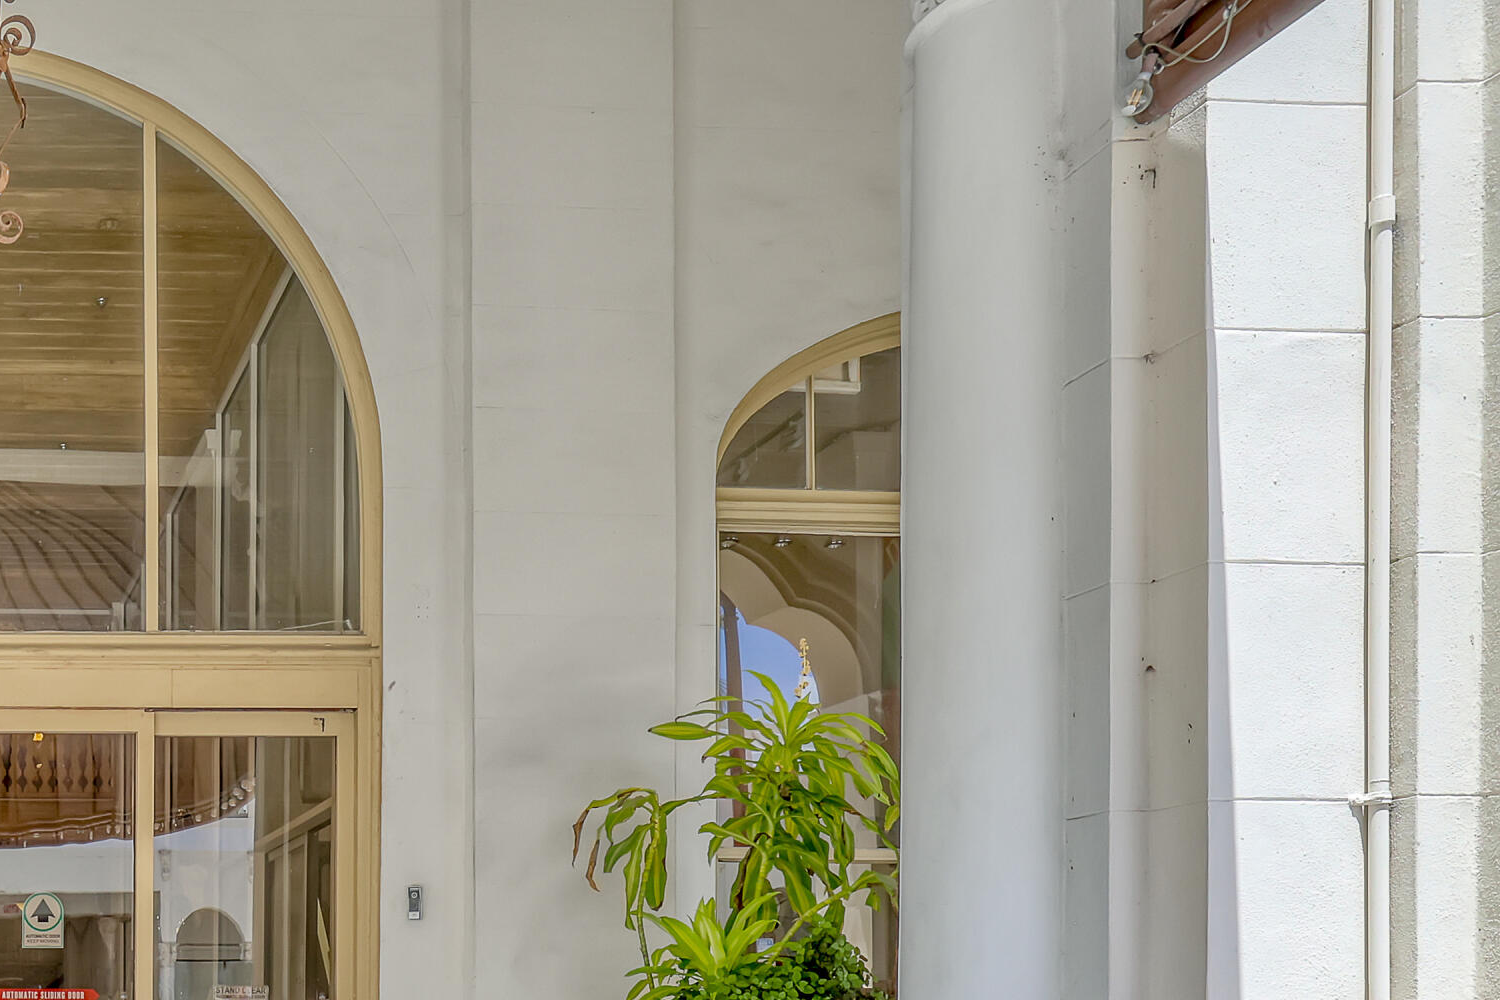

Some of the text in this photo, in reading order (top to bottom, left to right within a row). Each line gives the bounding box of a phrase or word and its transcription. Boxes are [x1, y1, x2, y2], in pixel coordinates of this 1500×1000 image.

[240, 985, 267, 994] CEAR
[1, 990, 85, 1000] AUTOMATIC SLIDING DOOR
